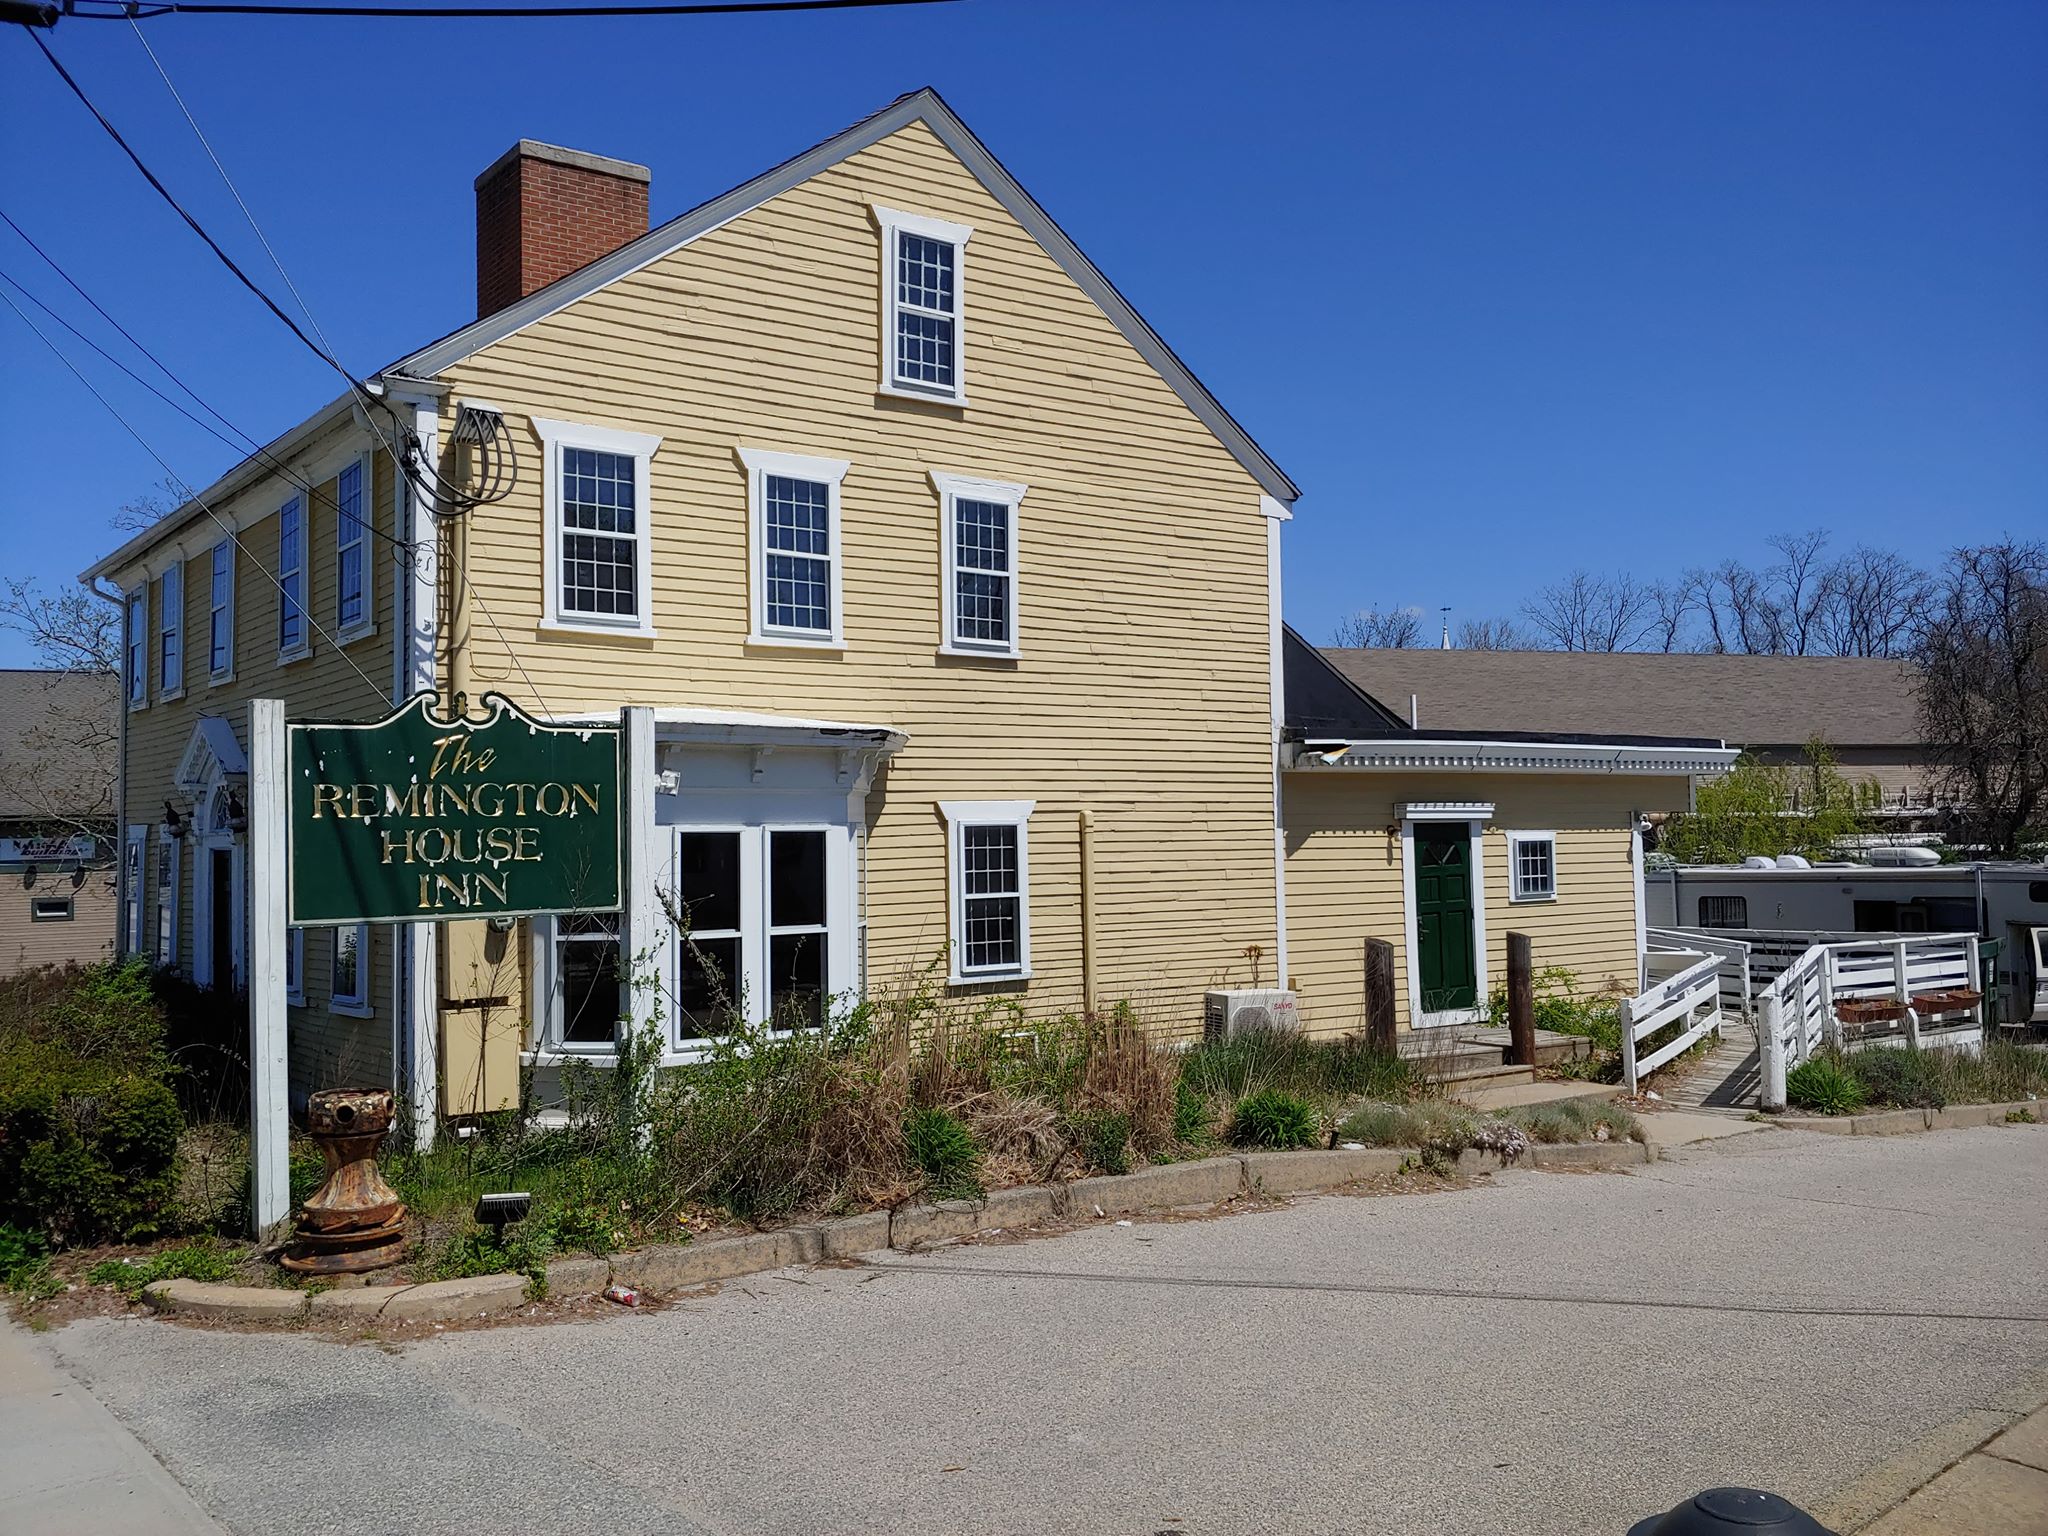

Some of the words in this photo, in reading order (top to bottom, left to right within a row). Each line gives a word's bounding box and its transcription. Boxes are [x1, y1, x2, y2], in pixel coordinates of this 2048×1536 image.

[430, 734, 498, 780] The
[312, 782, 601, 819] REMINGTON
[381, 827, 544, 864] HOUSE
[418, 871, 511, 908] INN
